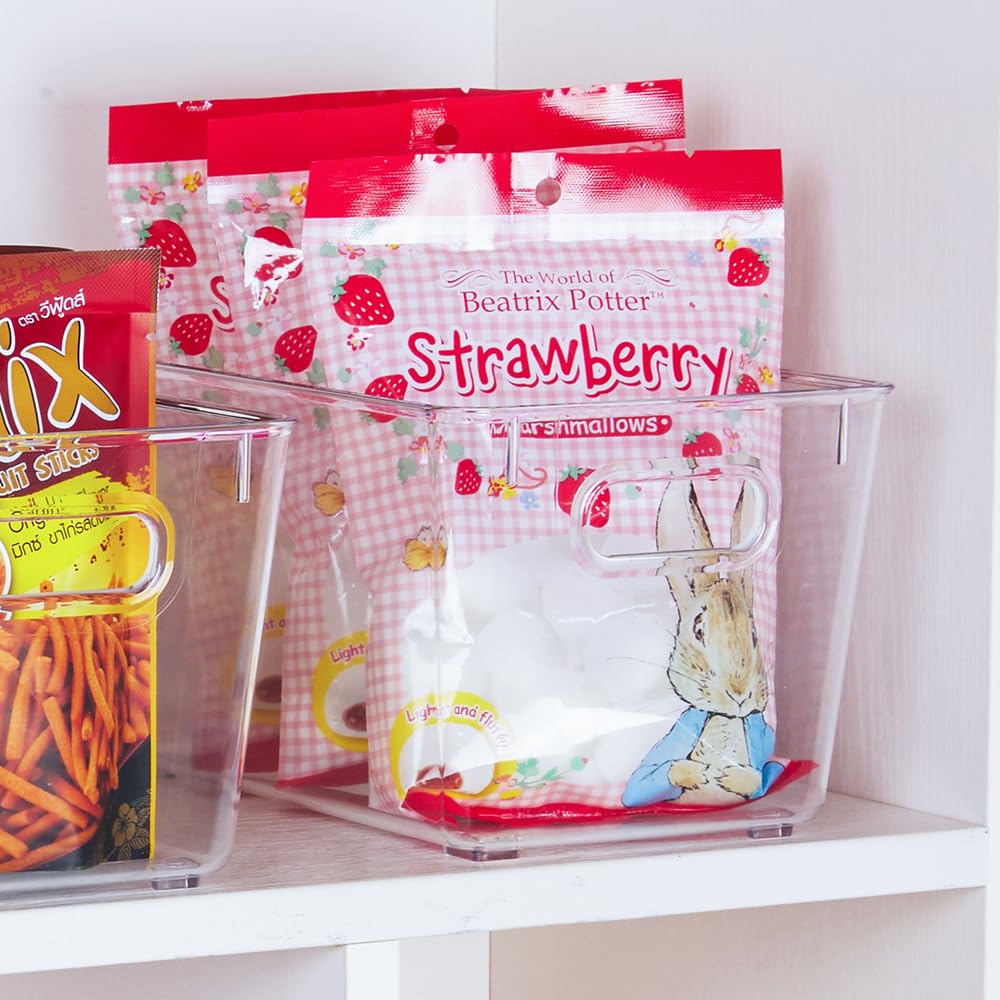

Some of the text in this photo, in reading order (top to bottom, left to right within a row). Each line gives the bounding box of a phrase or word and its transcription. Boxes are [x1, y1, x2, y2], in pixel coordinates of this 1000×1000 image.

[499, 269, 616, 285] The World of
[462, 290, 561, 313] Beatrix
[407, 323, 733, 397] Strawberry
